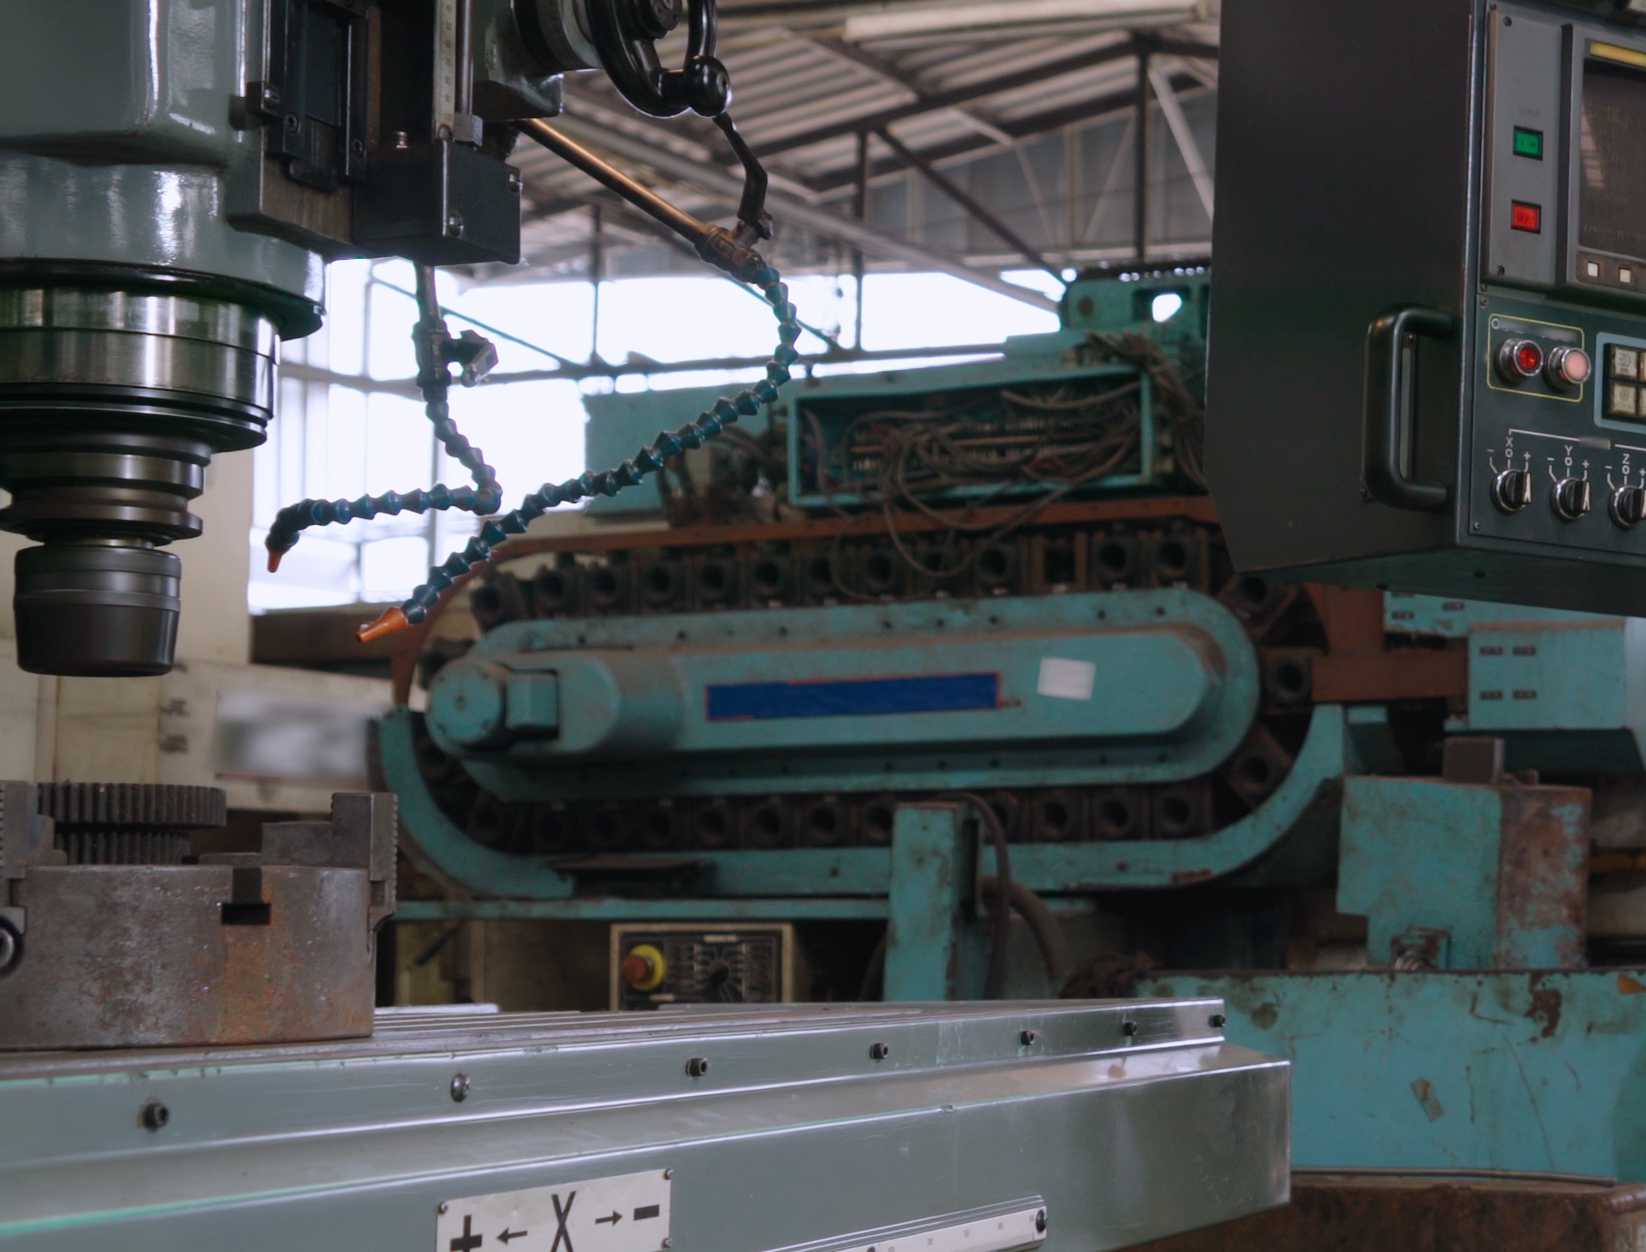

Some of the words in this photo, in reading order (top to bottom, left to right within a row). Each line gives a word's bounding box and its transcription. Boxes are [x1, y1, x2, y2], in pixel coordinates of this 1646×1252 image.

[1505, 436, 1514, 447] X
[1565, 445, 1574, 455] Y
[1622, 453, 1630, 464] Z
[551, 1190, 576, 1252] X
